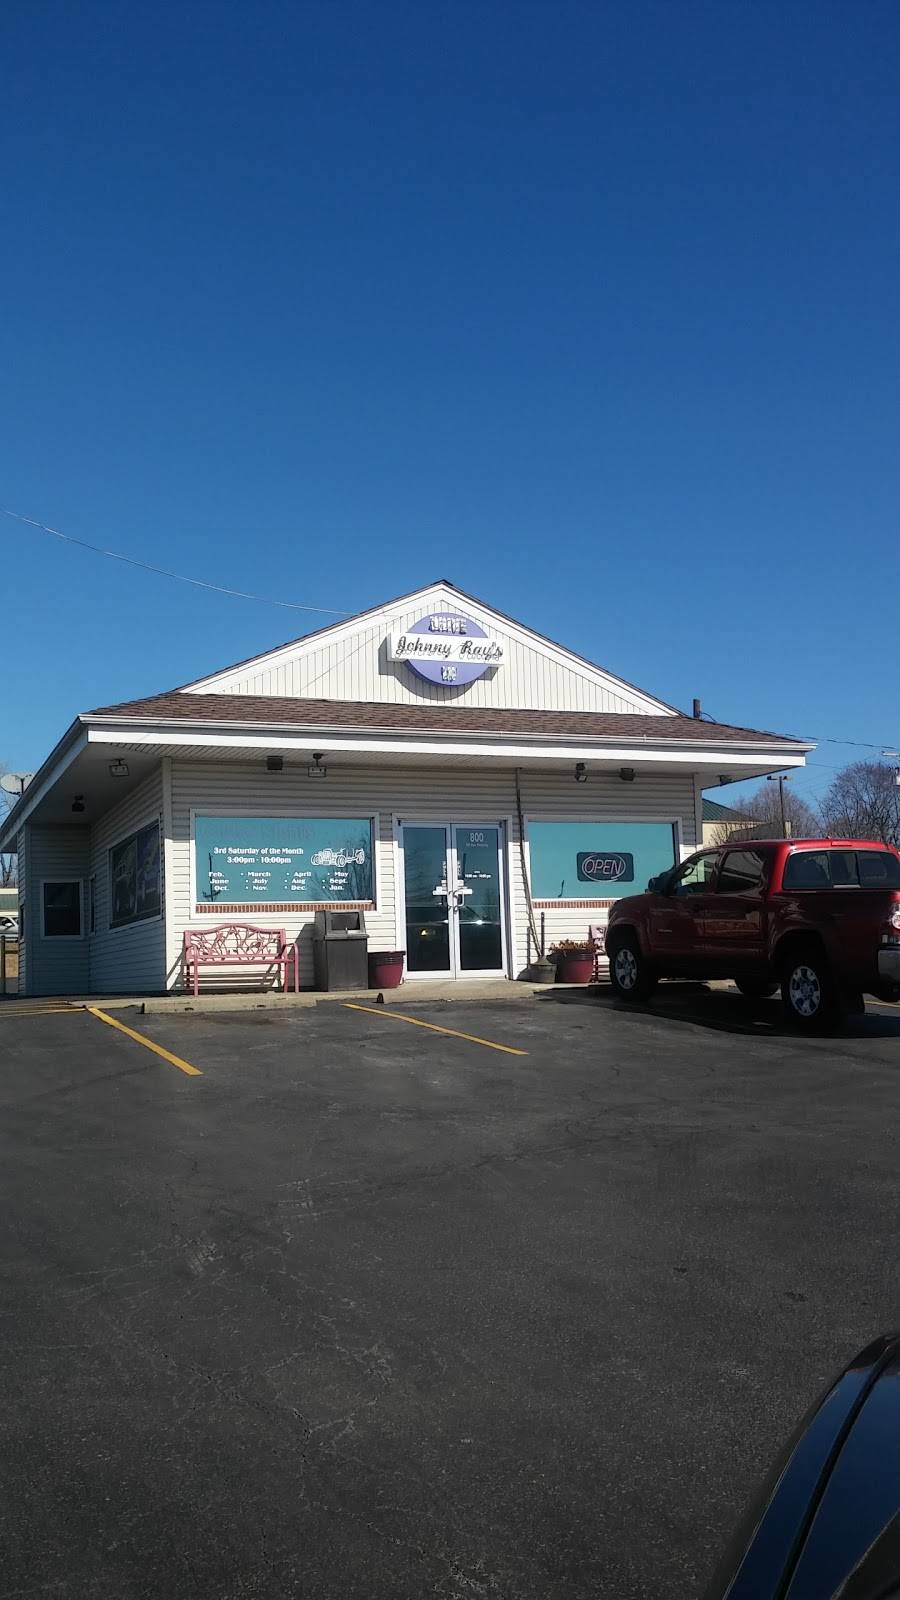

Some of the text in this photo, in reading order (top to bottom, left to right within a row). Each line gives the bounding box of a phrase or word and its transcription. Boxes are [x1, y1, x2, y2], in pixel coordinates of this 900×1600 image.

[396, 636, 503, 661] Johnny Ray's
[469, 832, 484, 842] 800
[213, 847, 304, 855] 3rd Saturday of the Month
[226, 856, 255, 864] 3:00pm
[260, 856, 292, 864] 10:00pm
[584, 859, 622, 875] OPEN
